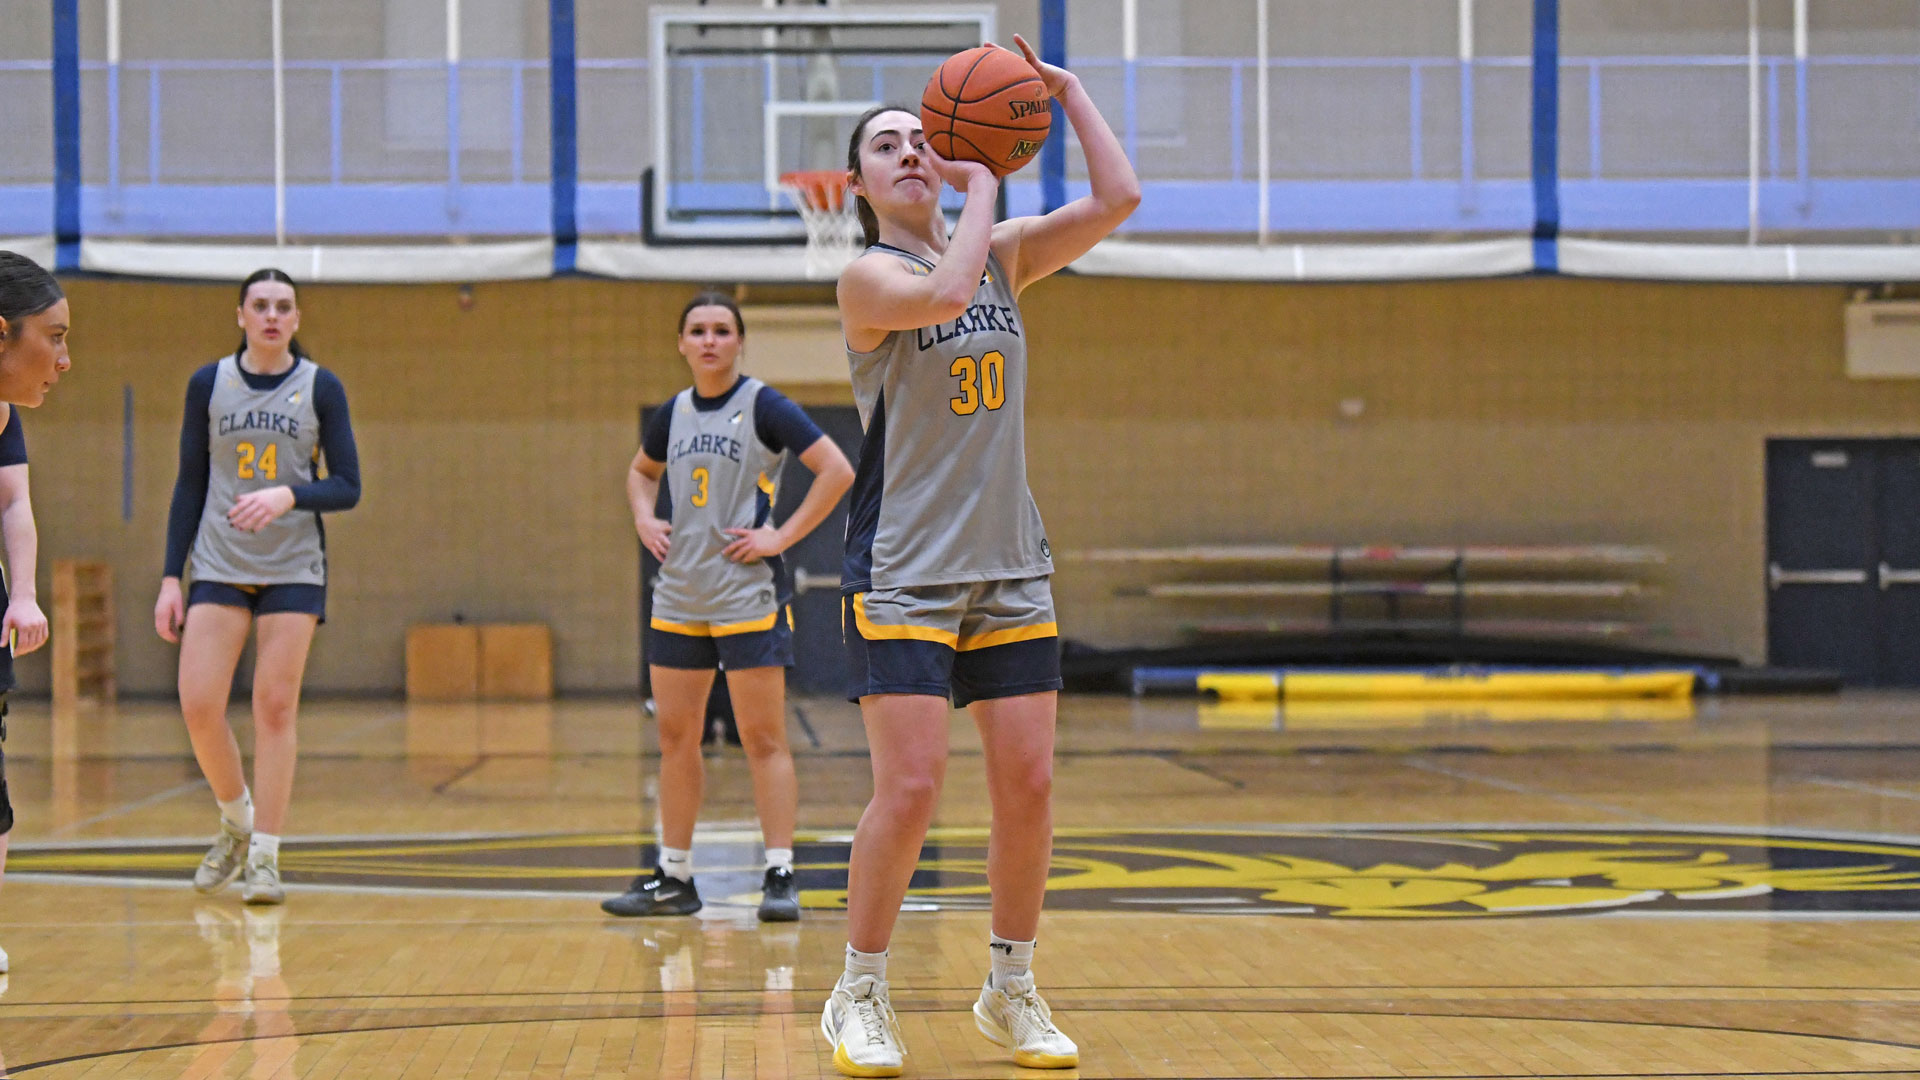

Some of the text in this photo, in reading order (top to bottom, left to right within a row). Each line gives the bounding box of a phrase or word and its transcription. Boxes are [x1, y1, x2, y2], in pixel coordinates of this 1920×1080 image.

[917, 304, 1020, 351] CLARKE
[950, 350, 1006, 416] 30
[218, 411, 299, 440] CLARKE
[236, 442, 278, 480] 24
[670, 434, 742, 465] CLARKE
[691, 467, 709, 507] 3
